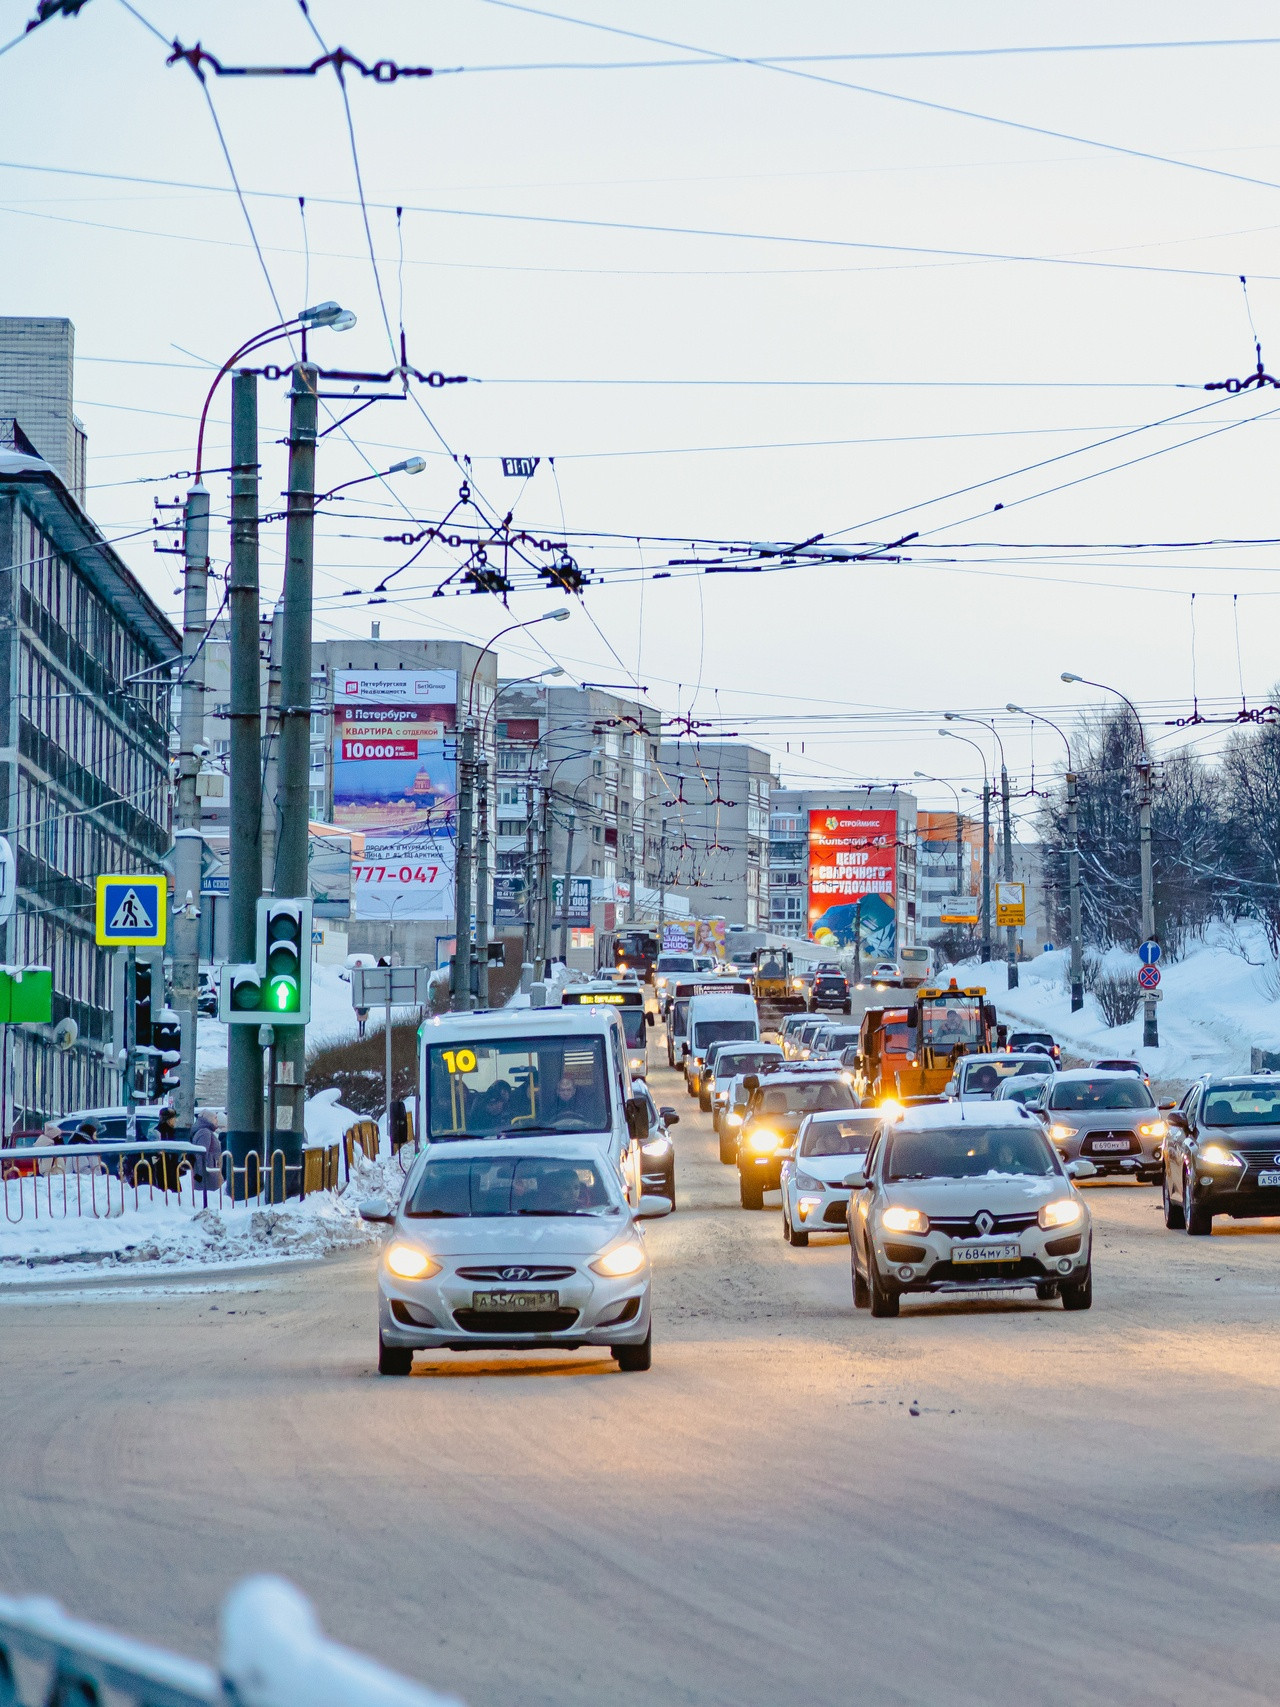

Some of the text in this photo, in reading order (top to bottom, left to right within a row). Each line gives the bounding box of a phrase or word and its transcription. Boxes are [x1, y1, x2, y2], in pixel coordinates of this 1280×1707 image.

[345, 709, 418, 721] В Петербурге
[345, 728, 393, 736] КВАРТИРА
[818, 835, 867, 845] Кольский
[836, 852, 869, 866] ЦЕНТР
[819, 866, 887, 879] СВАРОЧНОГО
[812, 880, 893, 894] ОБОРУДОВАНИЯ
[442, 1048, 476, 1074] 10
